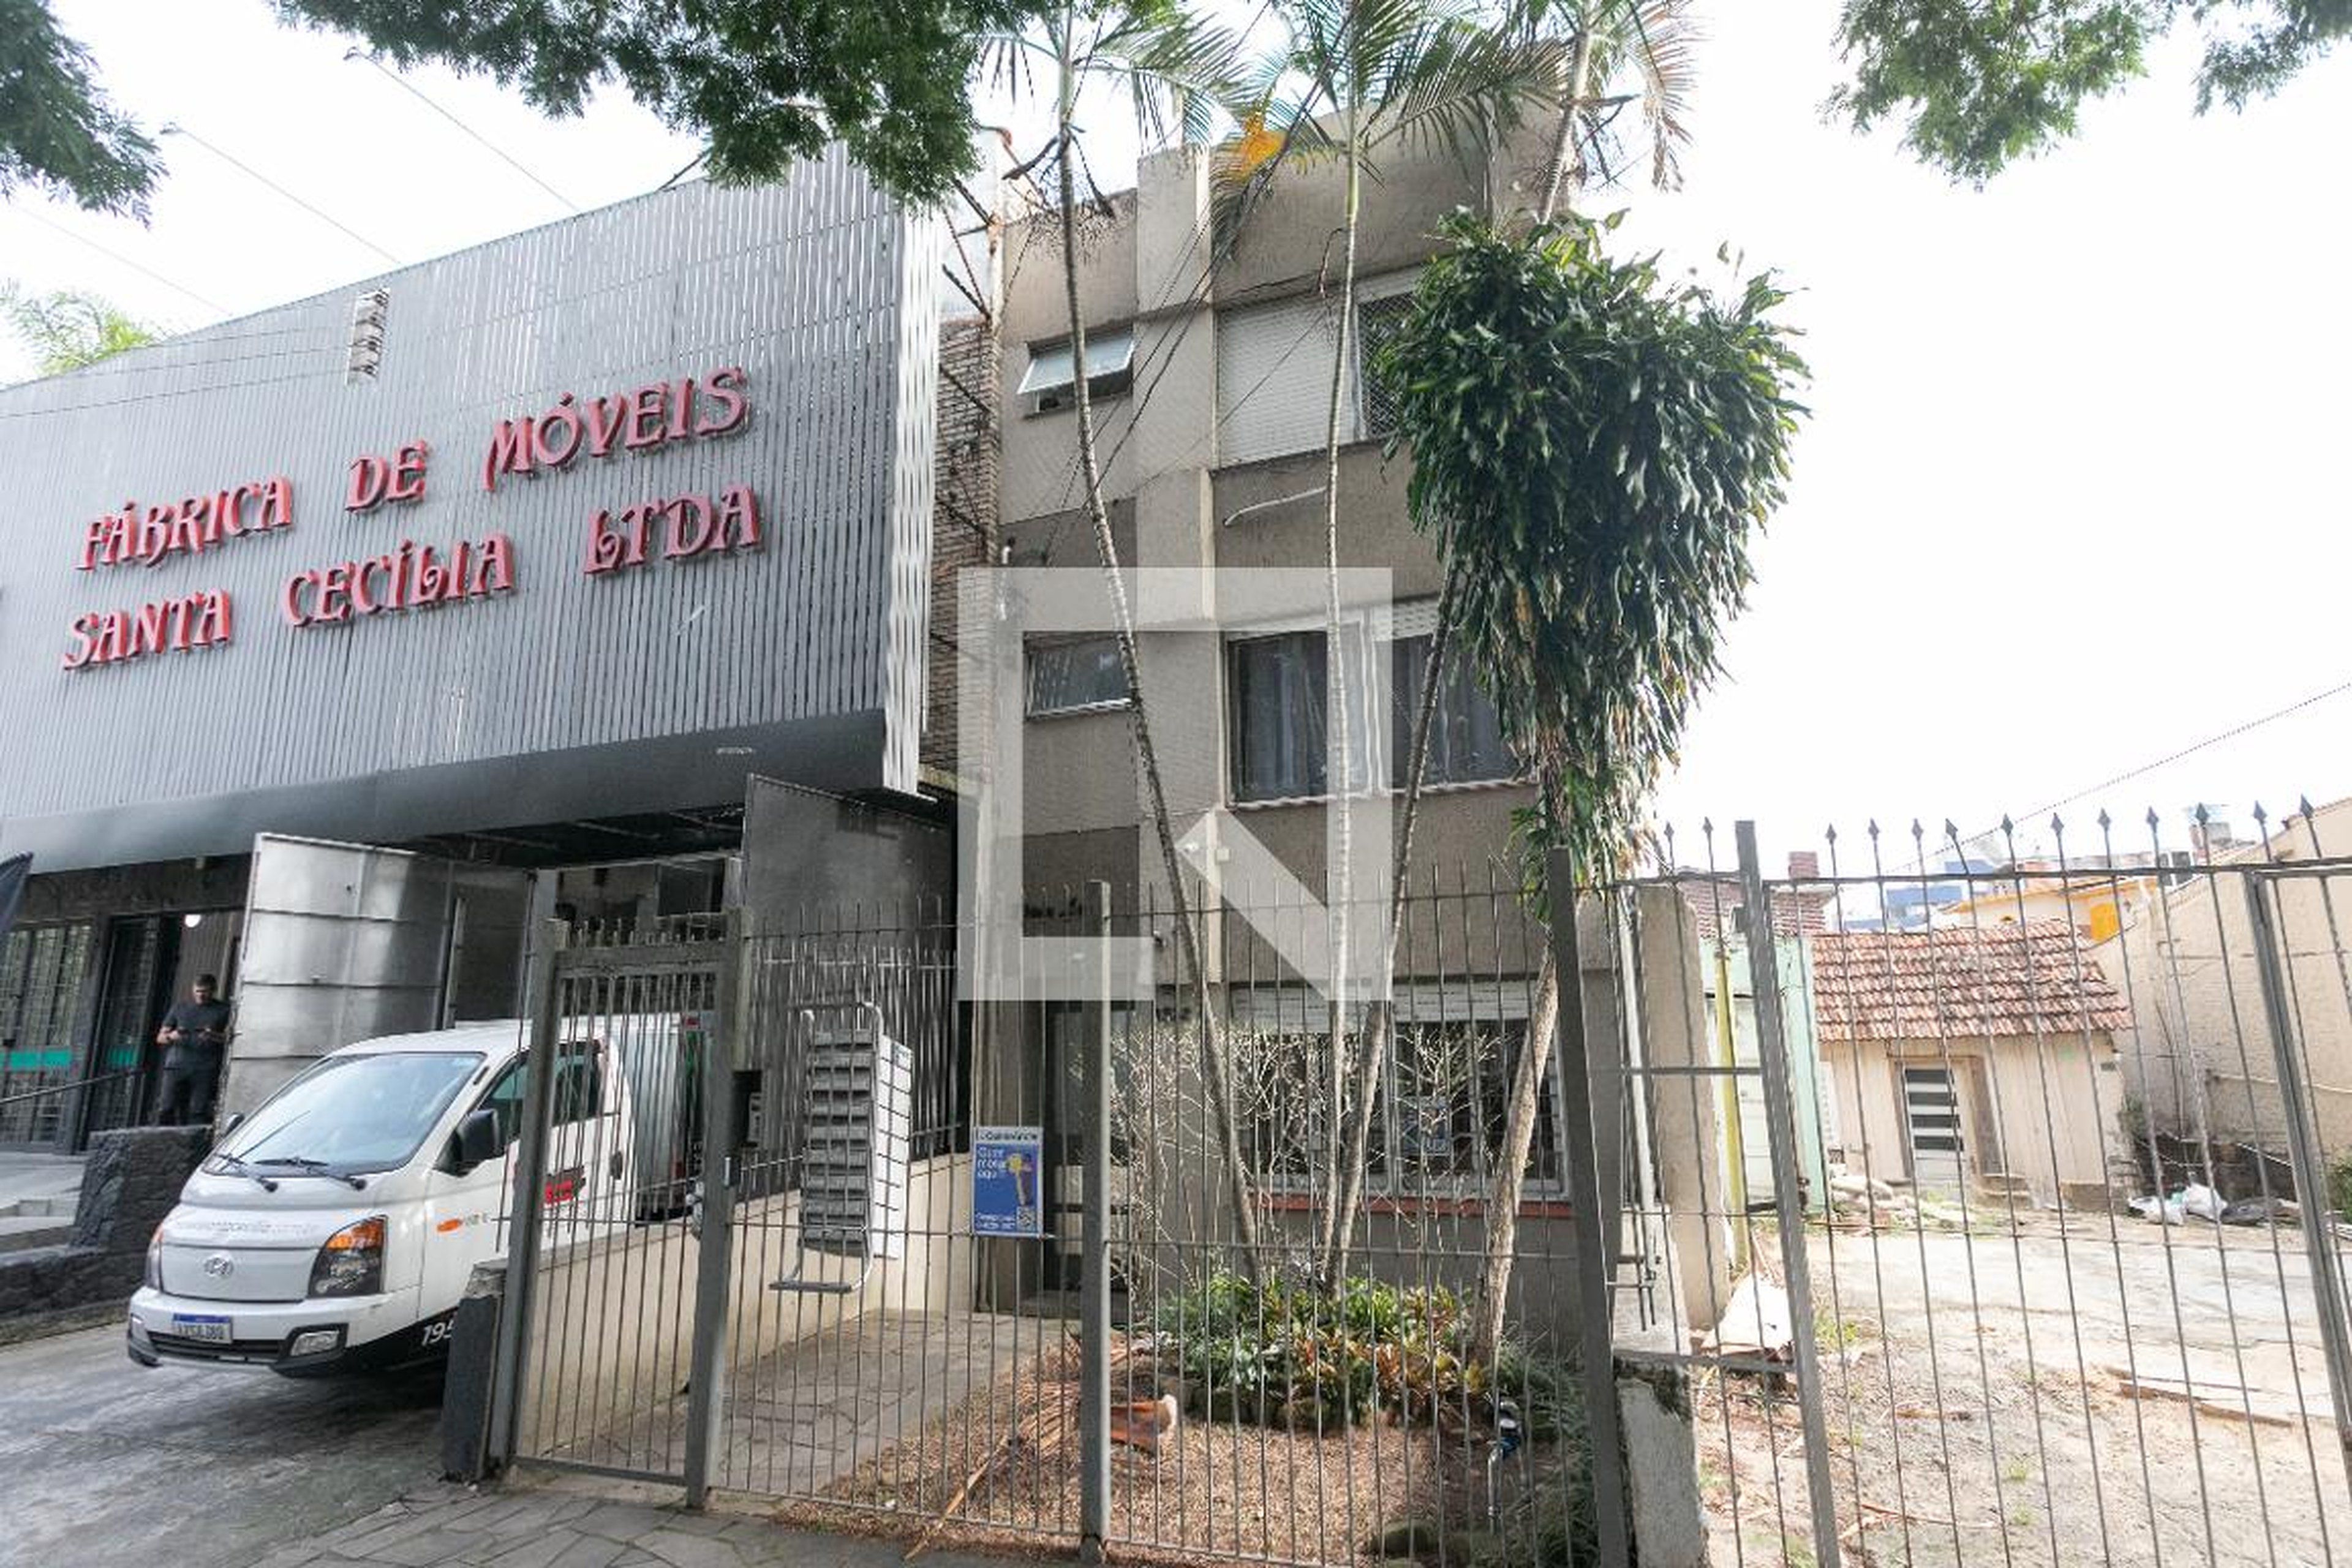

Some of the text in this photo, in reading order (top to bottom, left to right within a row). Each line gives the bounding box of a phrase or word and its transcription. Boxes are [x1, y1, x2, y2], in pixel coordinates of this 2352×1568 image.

[72, 366, 747, 570] FÁBRICA DE MÓVEIS
[64, 482, 760, 670] SANTA CECÍLIA LTDA
